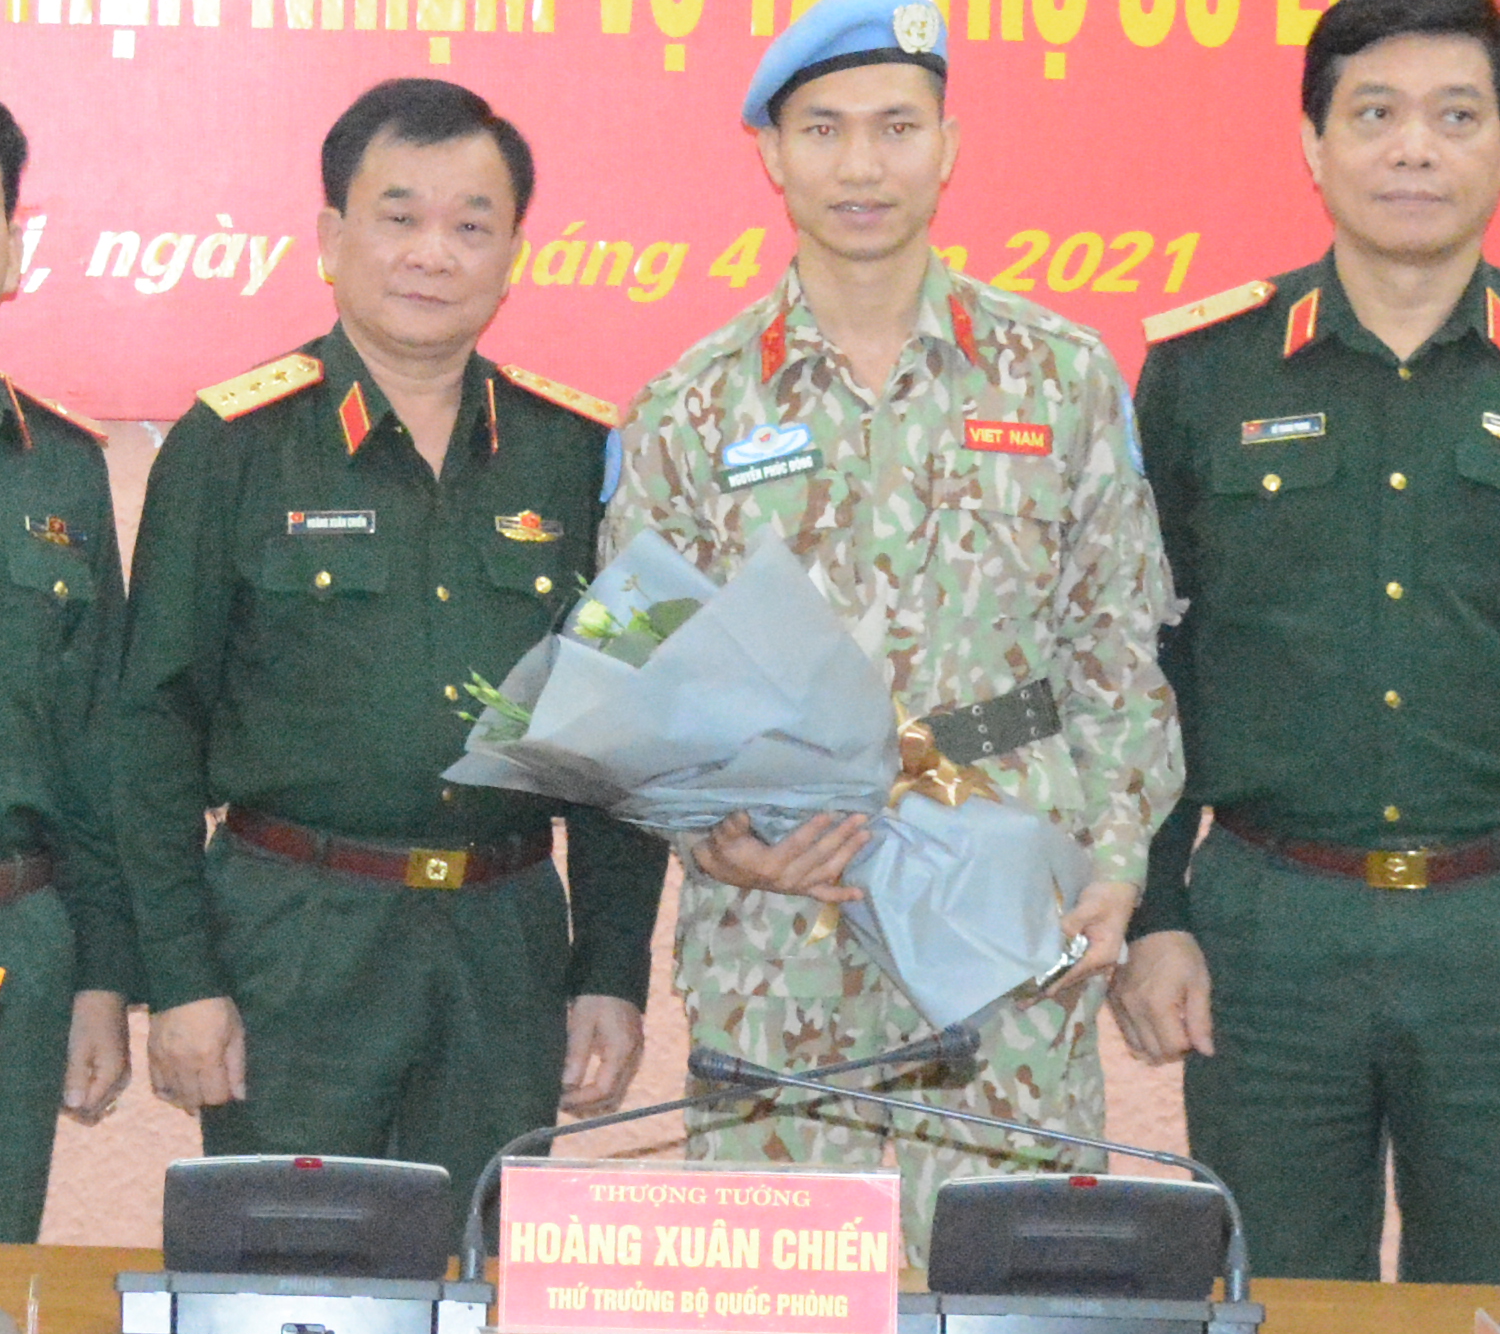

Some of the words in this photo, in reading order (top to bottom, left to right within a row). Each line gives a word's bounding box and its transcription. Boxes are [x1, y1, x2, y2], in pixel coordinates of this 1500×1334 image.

[85, 213, 295, 295] ngày
[510, 220, 690, 303] áng
[708, 228, 767, 288] 4
[990, 229, 1200, 293] 2021
[969, 427, 1003, 443] VIET
[1009, 430, 1044, 447] NAM
[590, 1184, 706, 1208] THƯỢNG
[715, 1185, 811, 1207] TƯỚNG
[511, 1215, 642, 1265] HOÀNG
[655, 1219, 760, 1269] XUÂN
[773, 1217, 888, 1272] CHIẾN
[547, 1282, 589, 1310] THỨ
[593, 1281, 674, 1313] TRƯỞNG
[681, 1287, 709, 1318] BỘ
[715, 1285, 770, 1316] QUỐC
[777, 1289, 848, 1318] PHÒNG
